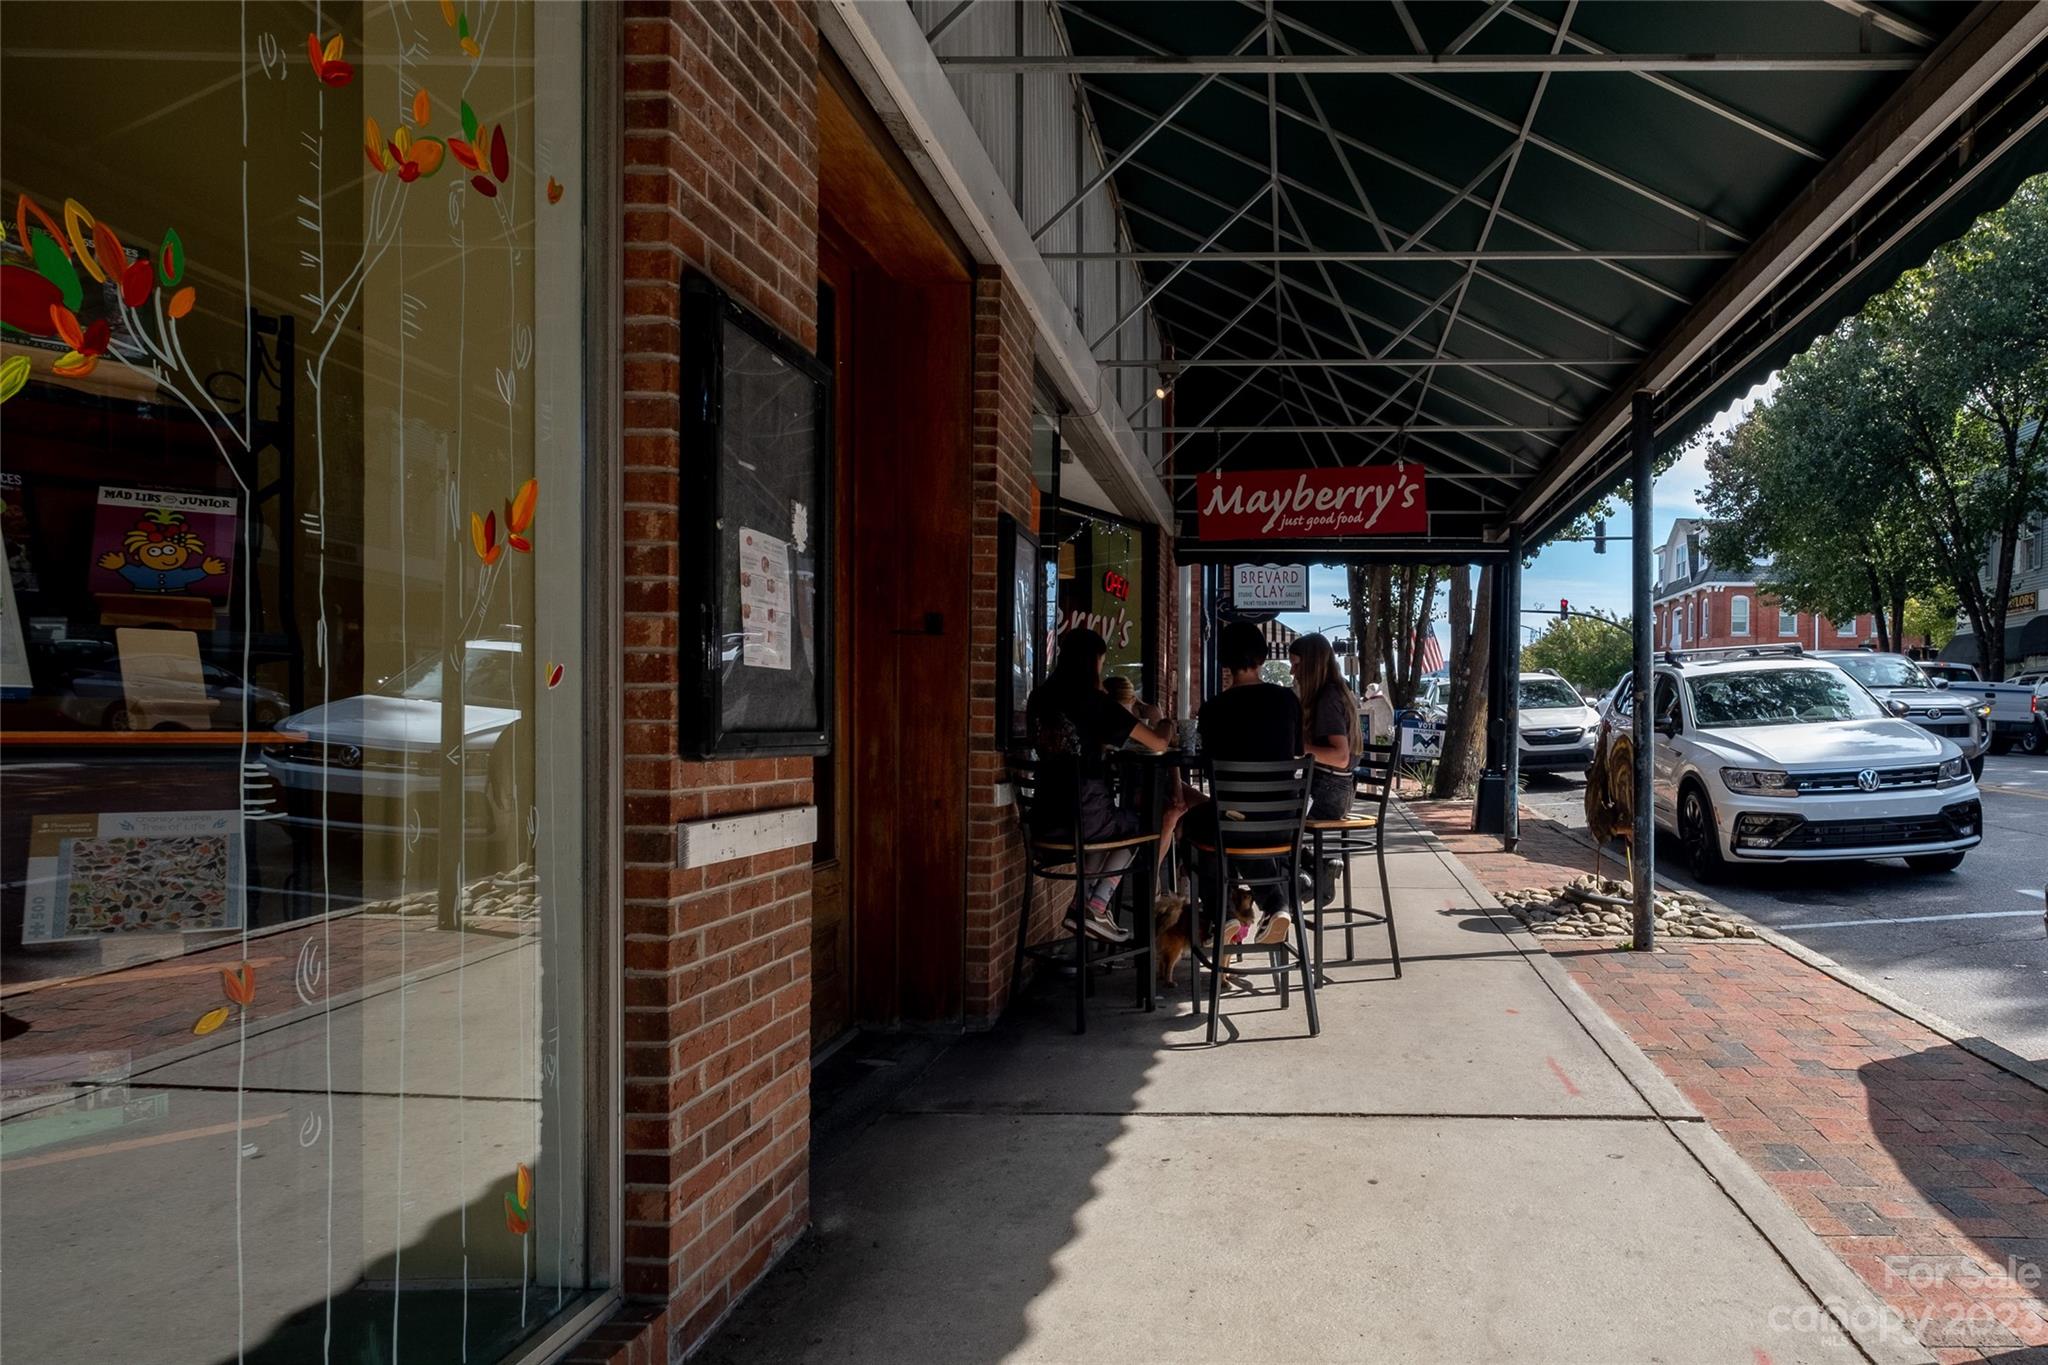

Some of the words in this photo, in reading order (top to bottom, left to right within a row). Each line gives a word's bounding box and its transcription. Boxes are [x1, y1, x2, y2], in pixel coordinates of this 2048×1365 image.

[103, 489, 132, 500] MAD
[135, 492, 161, 503] LIBS
[179, 497, 230, 508] JUNIOR
[1203, 474, 1420, 534] Mayberry's
[1279, 514, 1305, 531] just
[1306, 512, 1336, 531] good
[1334, 510, 1364, 529] food
[1105, 571, 1129, 600] OPEN
[1240, 571, 1299, 584] BREVARD
[1254, 585, 1286, 598] CLAY
[1417, 722, 1437, 730] VOTE
[168, 823, 182, 831] of
[184, 823, 207, 832] Life
[32, 896, 45, 920] 500
